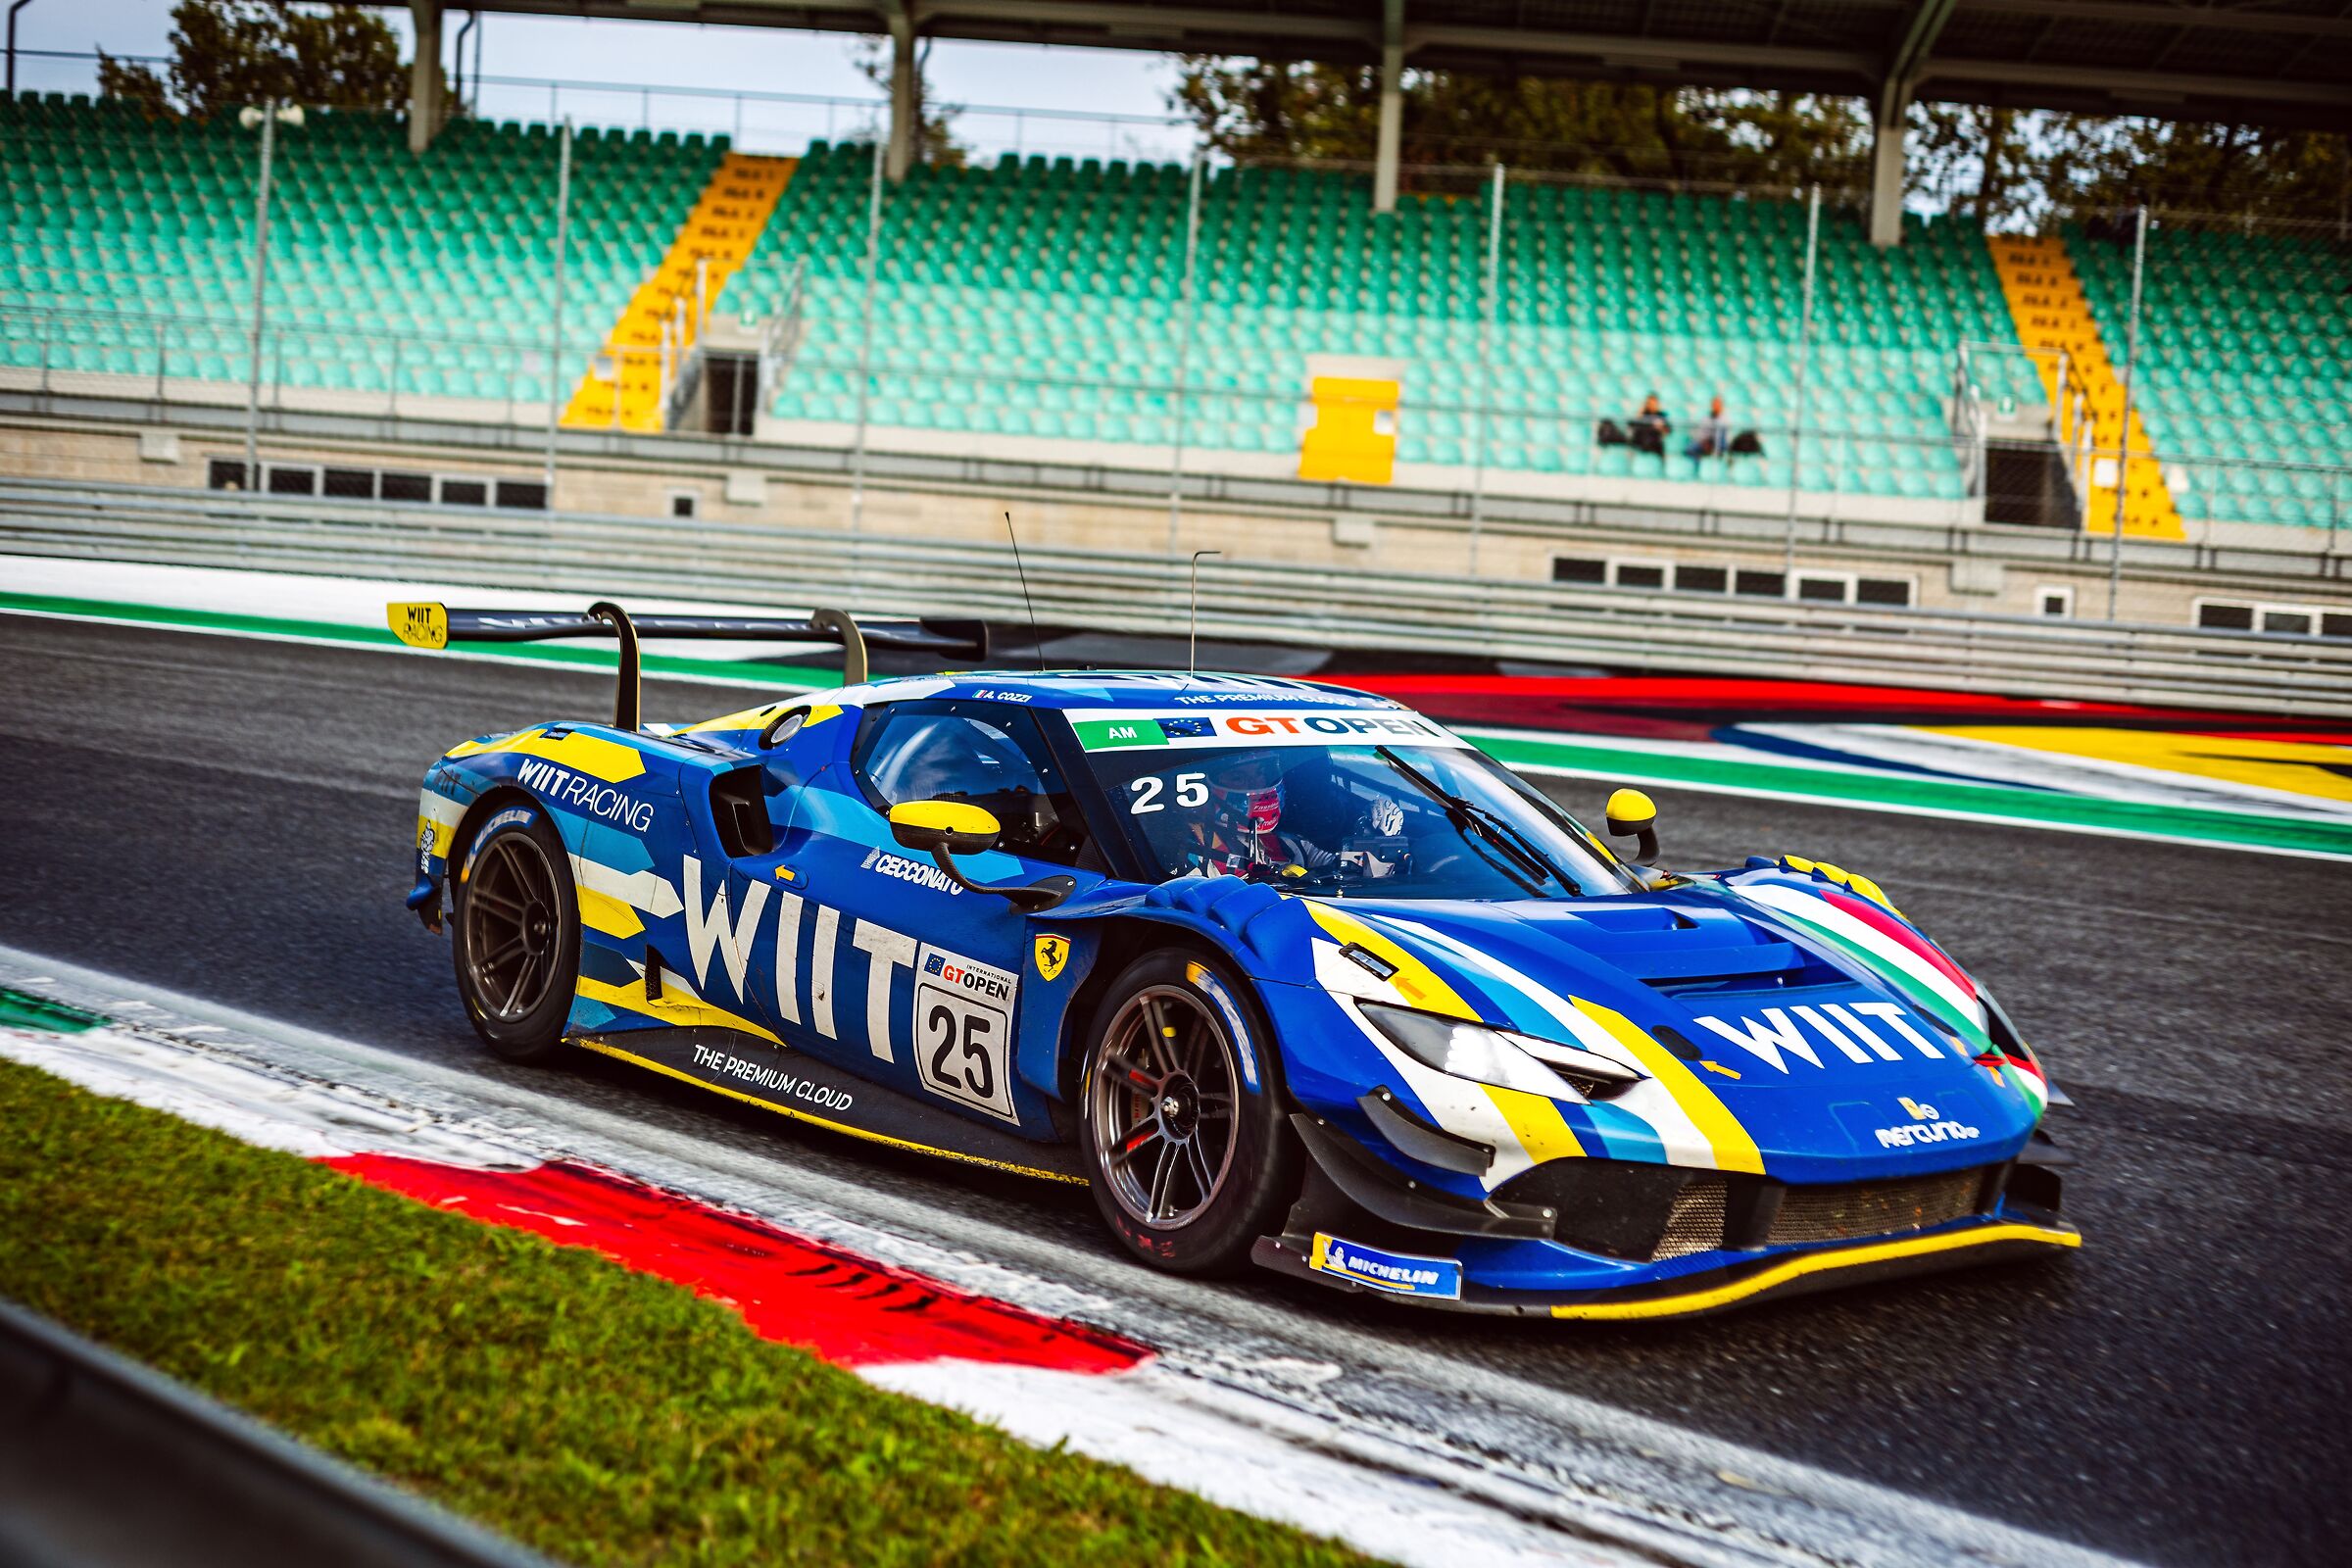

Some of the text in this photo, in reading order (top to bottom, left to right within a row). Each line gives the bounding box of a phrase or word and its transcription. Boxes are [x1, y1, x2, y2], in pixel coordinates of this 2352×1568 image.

[407, 607, 431, 623] WIIT
[983, 690, 1033, 704] A. COZZI
[1174, 694, 1216, 706] THE
[1213, 693, 1300, 704] PREMIUM
[1108, 725, 1138, 740] AM
[1130, 772, 1209, 815] 25
[683, 854, 918, 1064] WIIT
[966, 963, 1012, 985] INTERNATIONAL
[928, 1004, 995, 1100] 25
[1692, 1001, 1946, 1075] WIIT
[692, 1043, 854, 1112] THE PREMIUM CLOUD
[1348, 1255, 1440, 1286] MICHELIN
